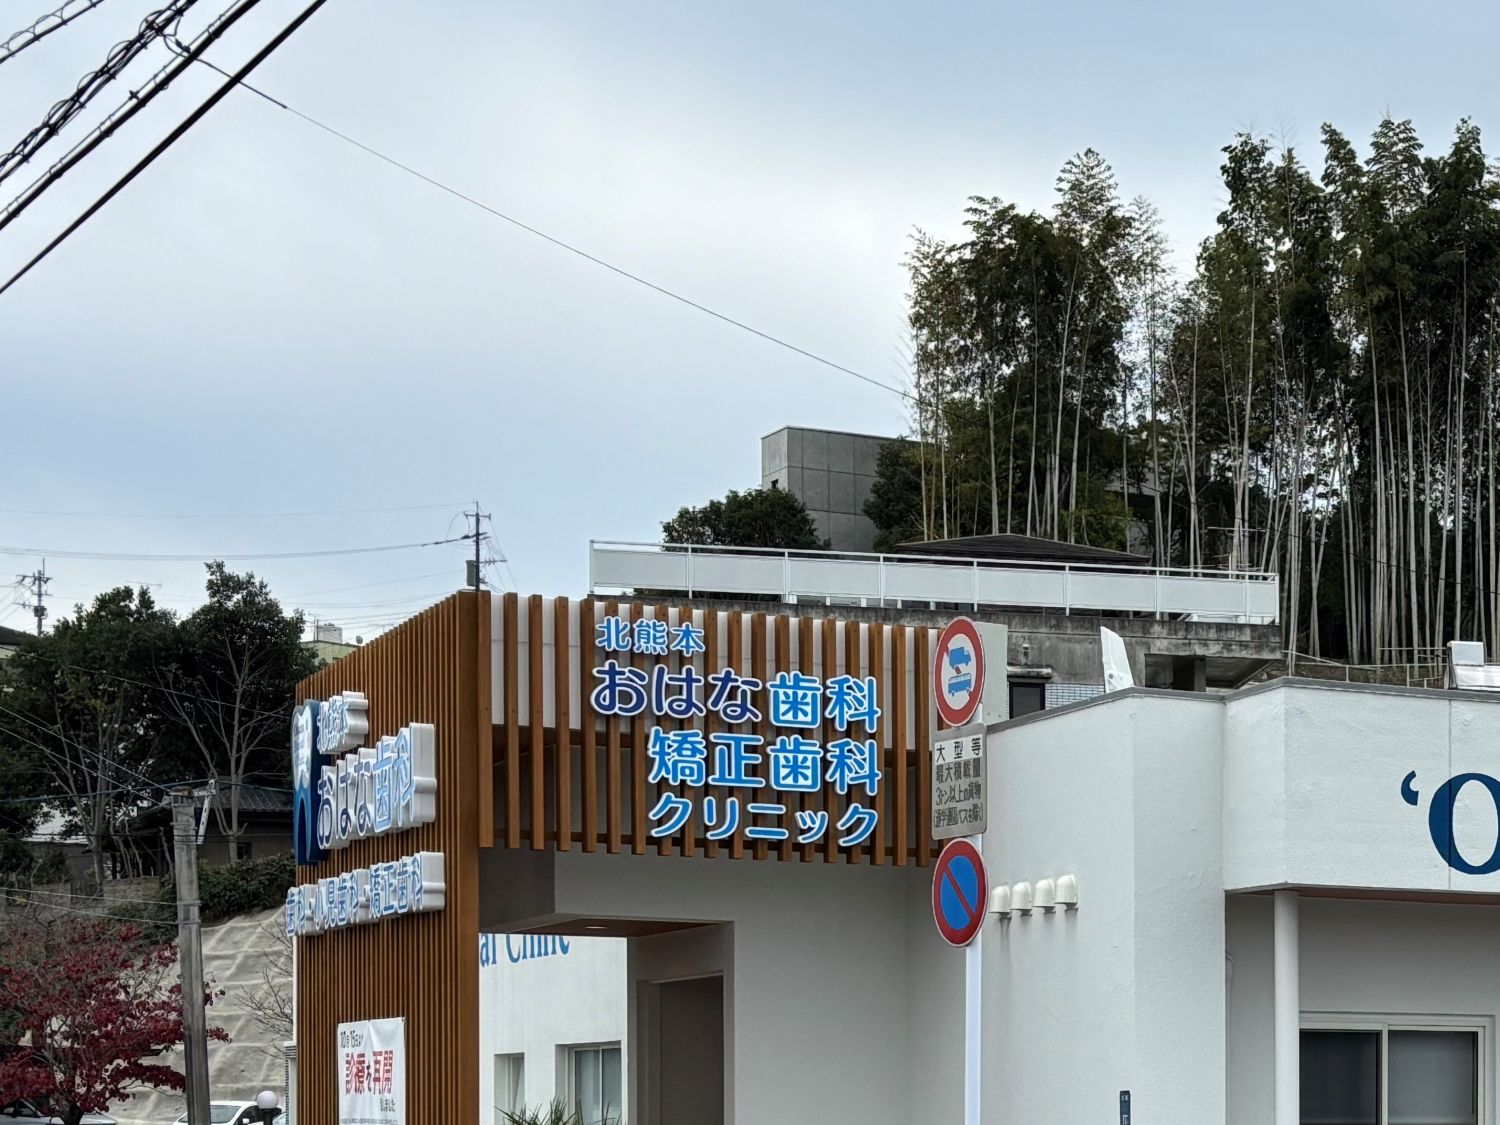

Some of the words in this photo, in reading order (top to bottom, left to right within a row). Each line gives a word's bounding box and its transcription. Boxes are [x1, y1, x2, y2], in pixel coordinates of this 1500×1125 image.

[595, 616, 706, 657] 北熊本
[590, 660, 881, 733] おはな歯科
[317, 701, 349, 752] 北熊本
[936, 737, 982, 763] 大型等
[647, 726, 882, 796] 矯正歯科
[317, 726, 416, 850] おはな歯科
[648, 792, 879, 847] クリニック
[345, 1050, 394, 1095] 診療を再開
